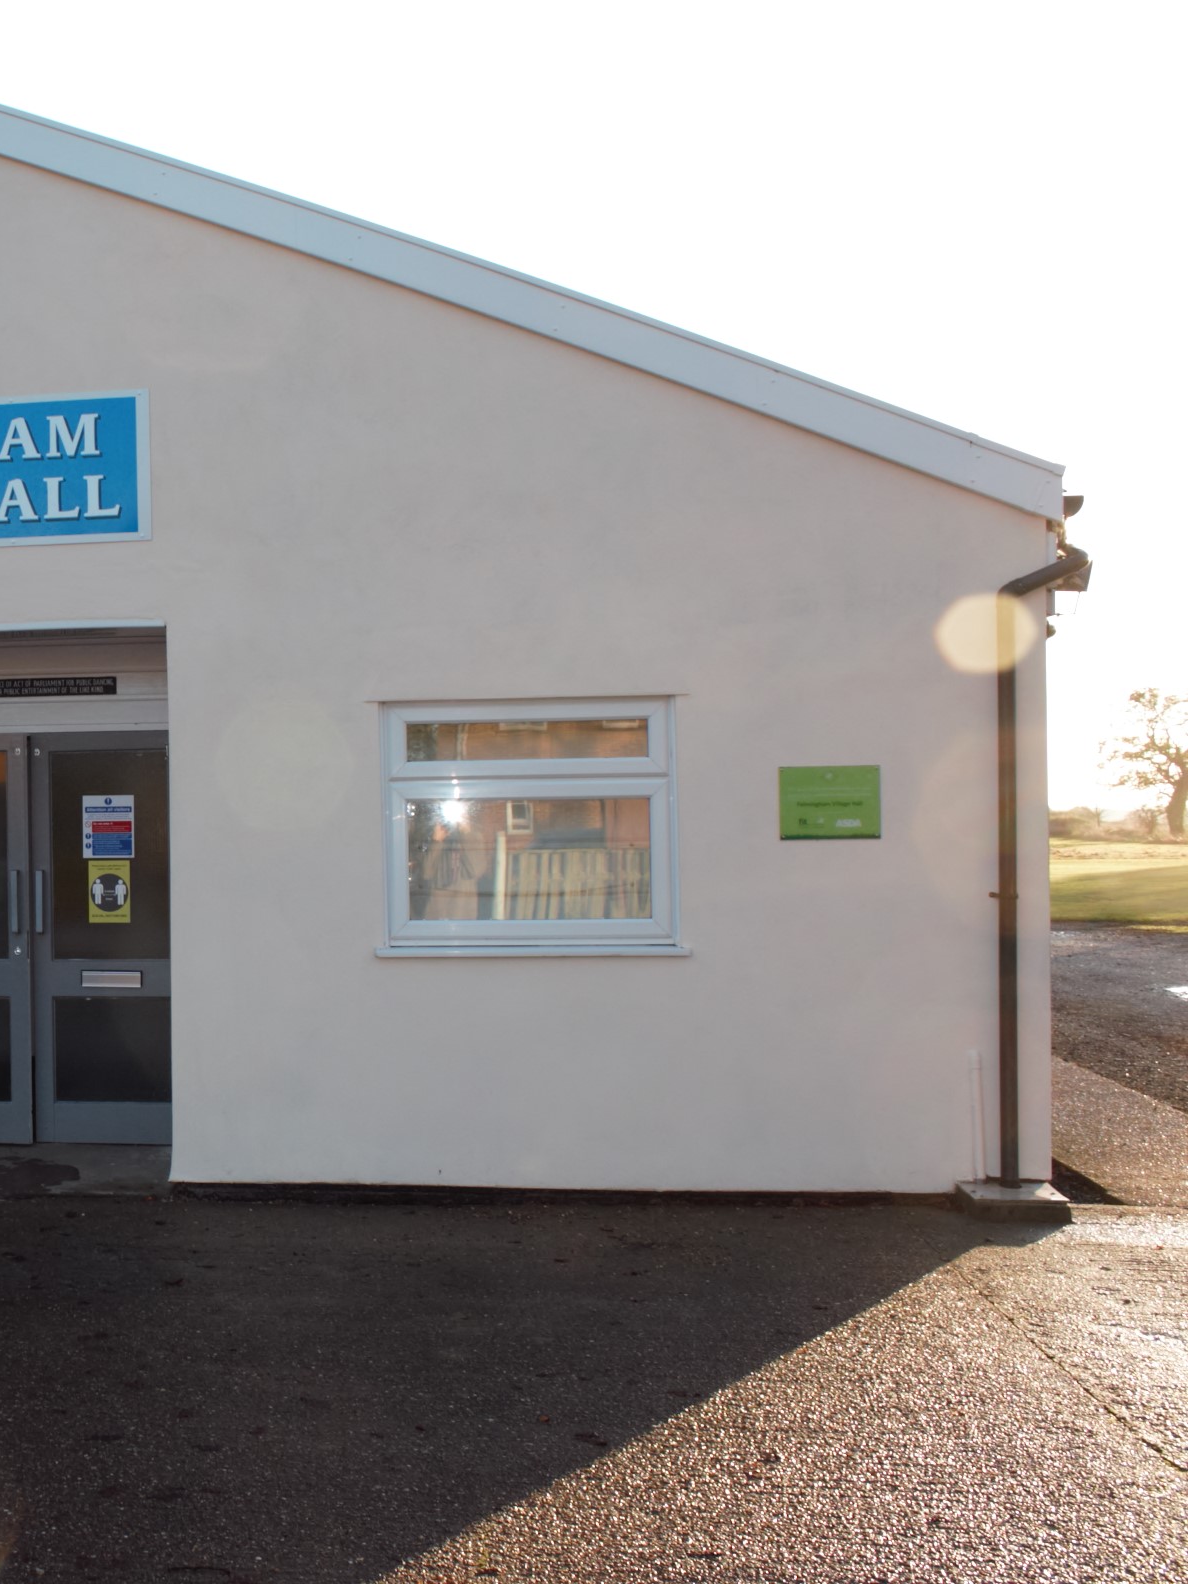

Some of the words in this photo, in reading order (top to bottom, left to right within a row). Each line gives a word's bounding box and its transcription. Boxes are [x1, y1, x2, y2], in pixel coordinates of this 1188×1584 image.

[33, 679, 65, 687] PARLIAMENT
[21, 687, 60, 695] ENTERTAINMENT
[835, 818, 862, 828] ASDA
